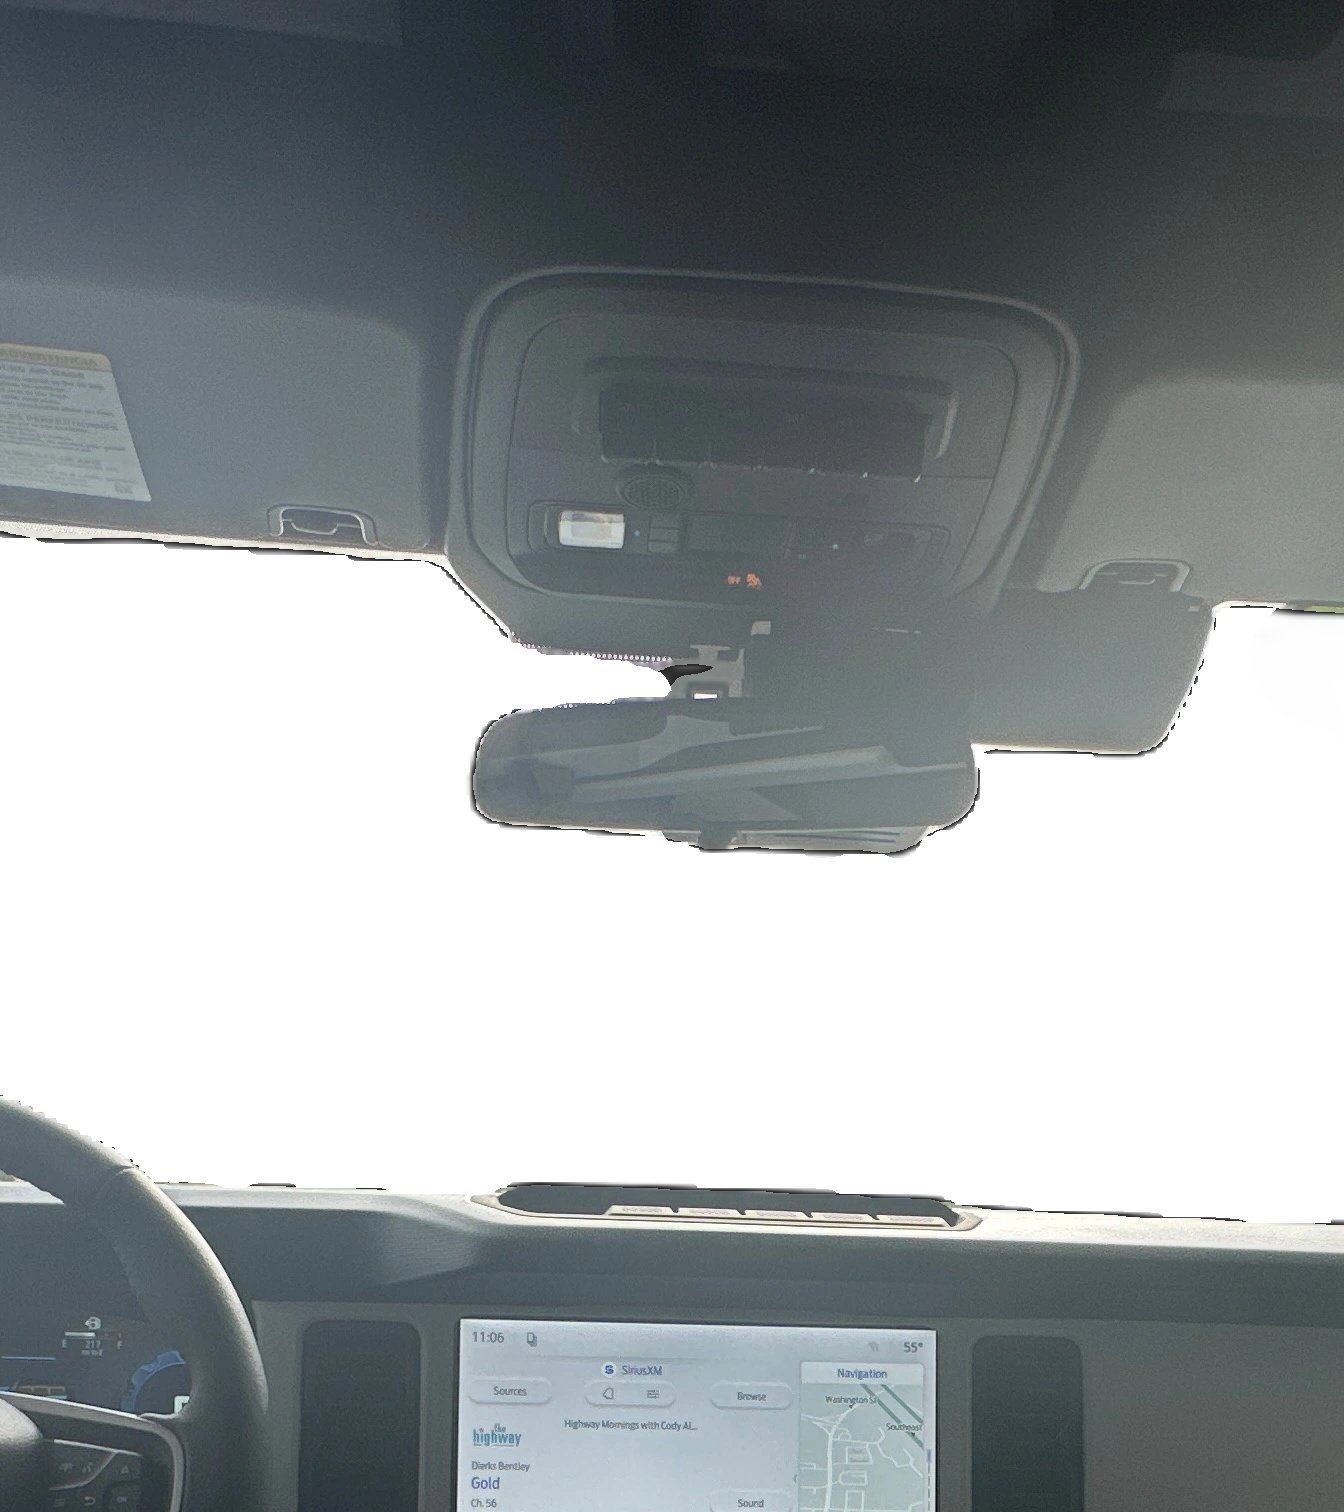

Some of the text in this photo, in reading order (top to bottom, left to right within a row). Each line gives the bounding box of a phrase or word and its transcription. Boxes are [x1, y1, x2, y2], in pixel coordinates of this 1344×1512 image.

[472, 1331, 505, 1343] 11:06
[622, 1365, 663, 1376] SiriusXM
[837, 1369, 888, 1380] Navigation
[493, 1386, 527, 1397] Sources
[737, 1391, 767, 1401] Browse
[825, 1395, 869, 1405] Washington
[564, 1419, 600, 1431] Highway
[601, 1420, 640, 1431] Mornings
[641, 1421, 660, 1430] with
[660, 1421, 682, 1431] Cody
[473, 1429, 522, 1447] highway
[471, 1461, 530, 1473] Dierks Bentley
[471, 1476, 500, 1489] Gold
[485, 1498, 497, 1508] 56
[737, 1498, 764, 1508] Sound
